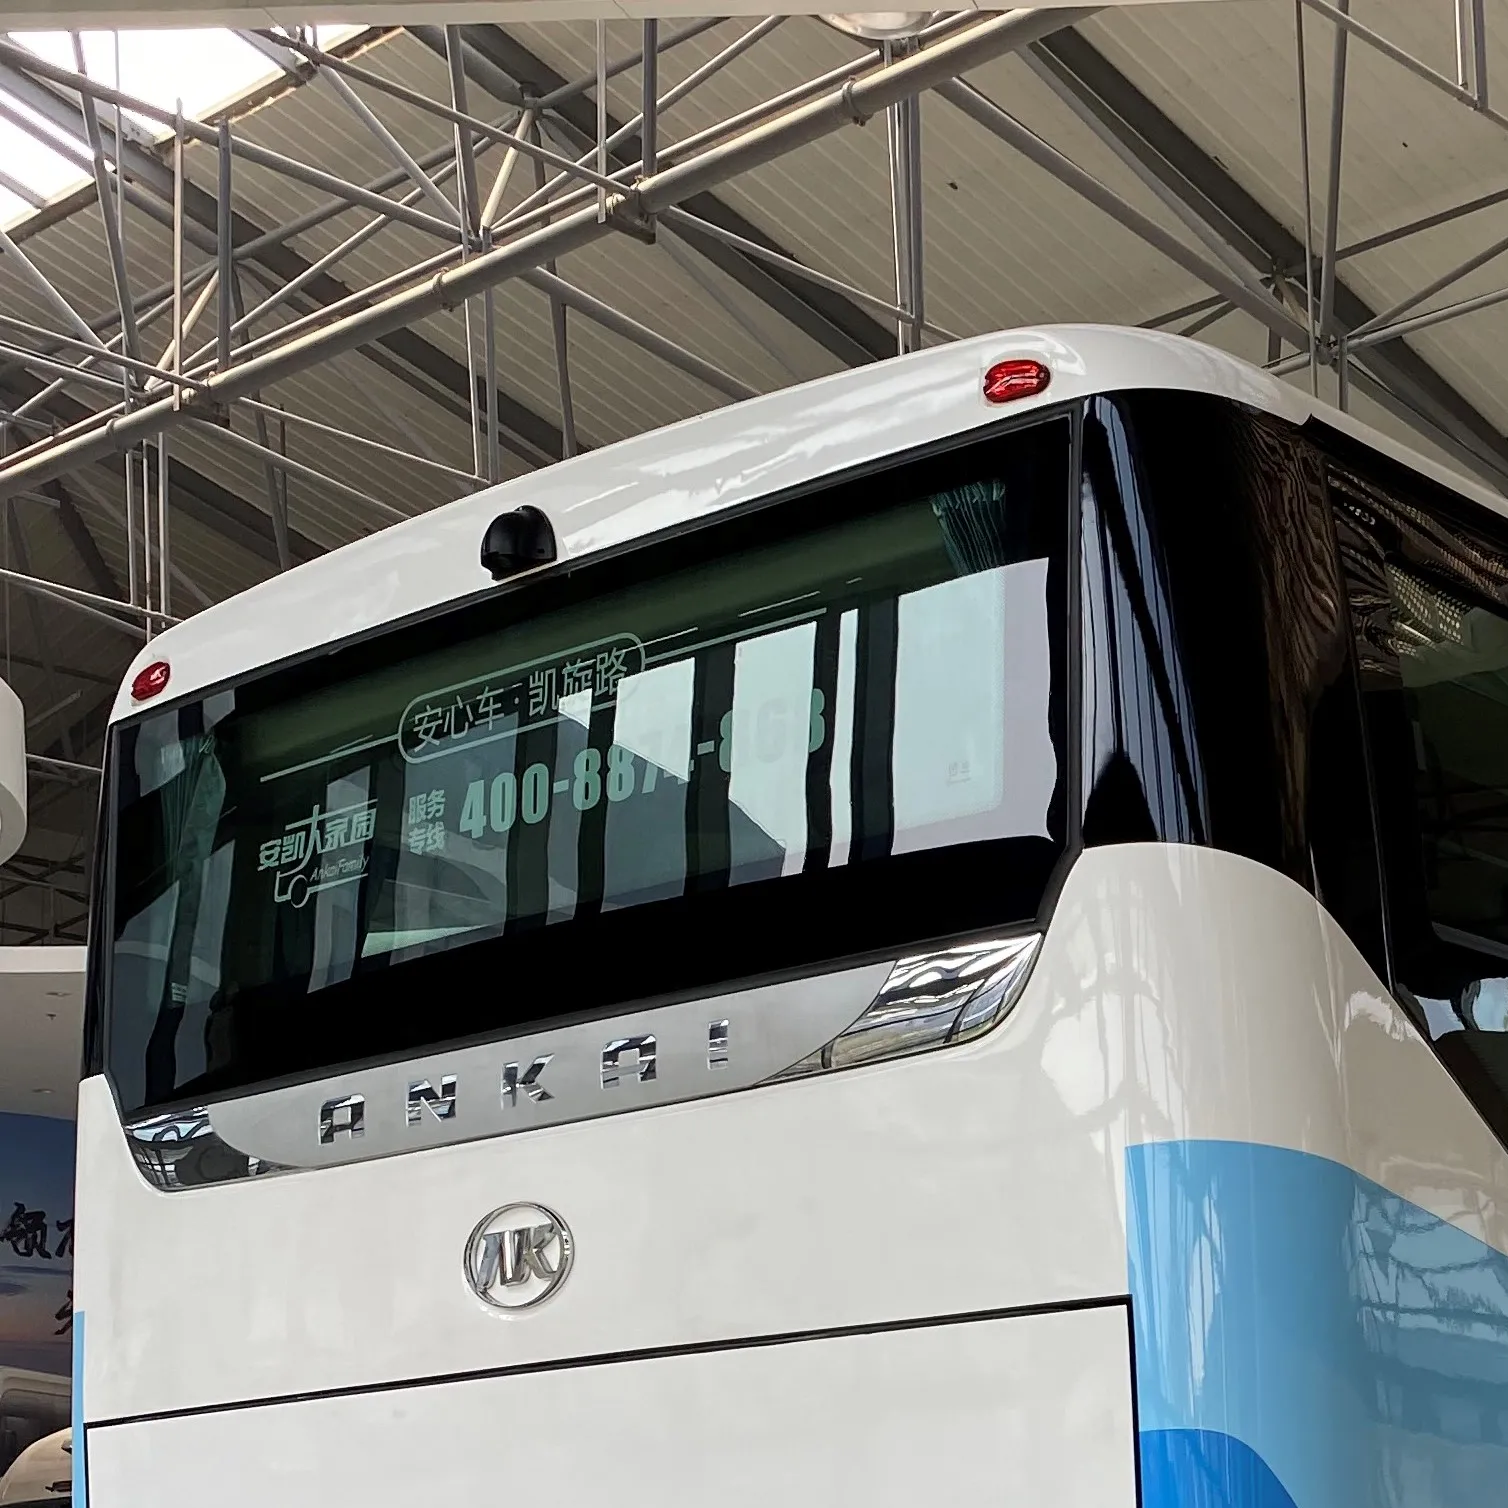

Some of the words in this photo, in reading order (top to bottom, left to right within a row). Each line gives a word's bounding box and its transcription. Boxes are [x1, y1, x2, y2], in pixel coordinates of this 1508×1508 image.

[408, 789, 446, 824] 服务
[408, 821, 446, 855] 专线
[319, 1018, 730, 1145] ANKAI
